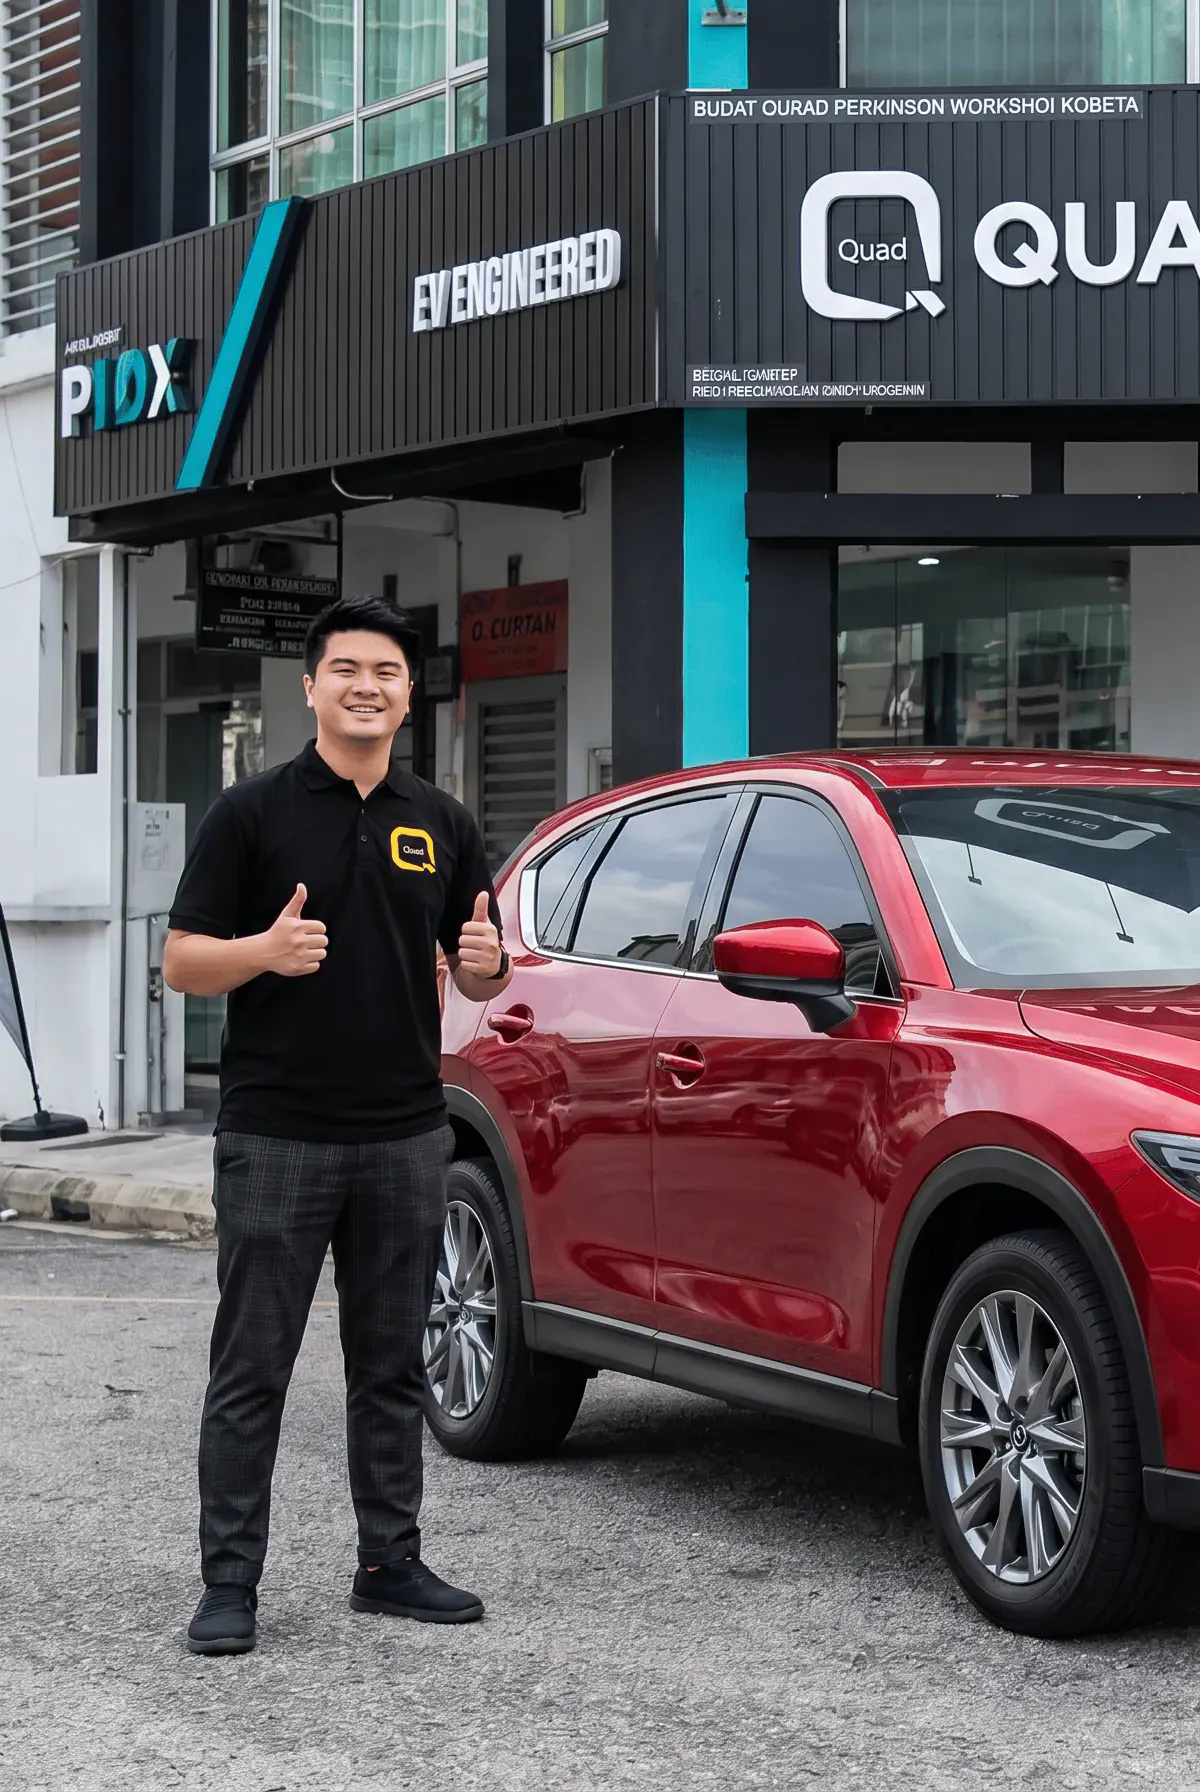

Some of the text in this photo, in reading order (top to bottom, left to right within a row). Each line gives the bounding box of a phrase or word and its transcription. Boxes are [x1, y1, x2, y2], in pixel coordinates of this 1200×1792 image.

[694, 100, 757, 117] BUDAT
[834, 98, 944, 117] PERKINSON
[950, 97, 1055, 115] WORKSHOI
[1061, 96, 1139, 114] KOBETA
[838, 238, 907, 265] Quad
[412, 227, 622, 333] EV ENGINEERED
